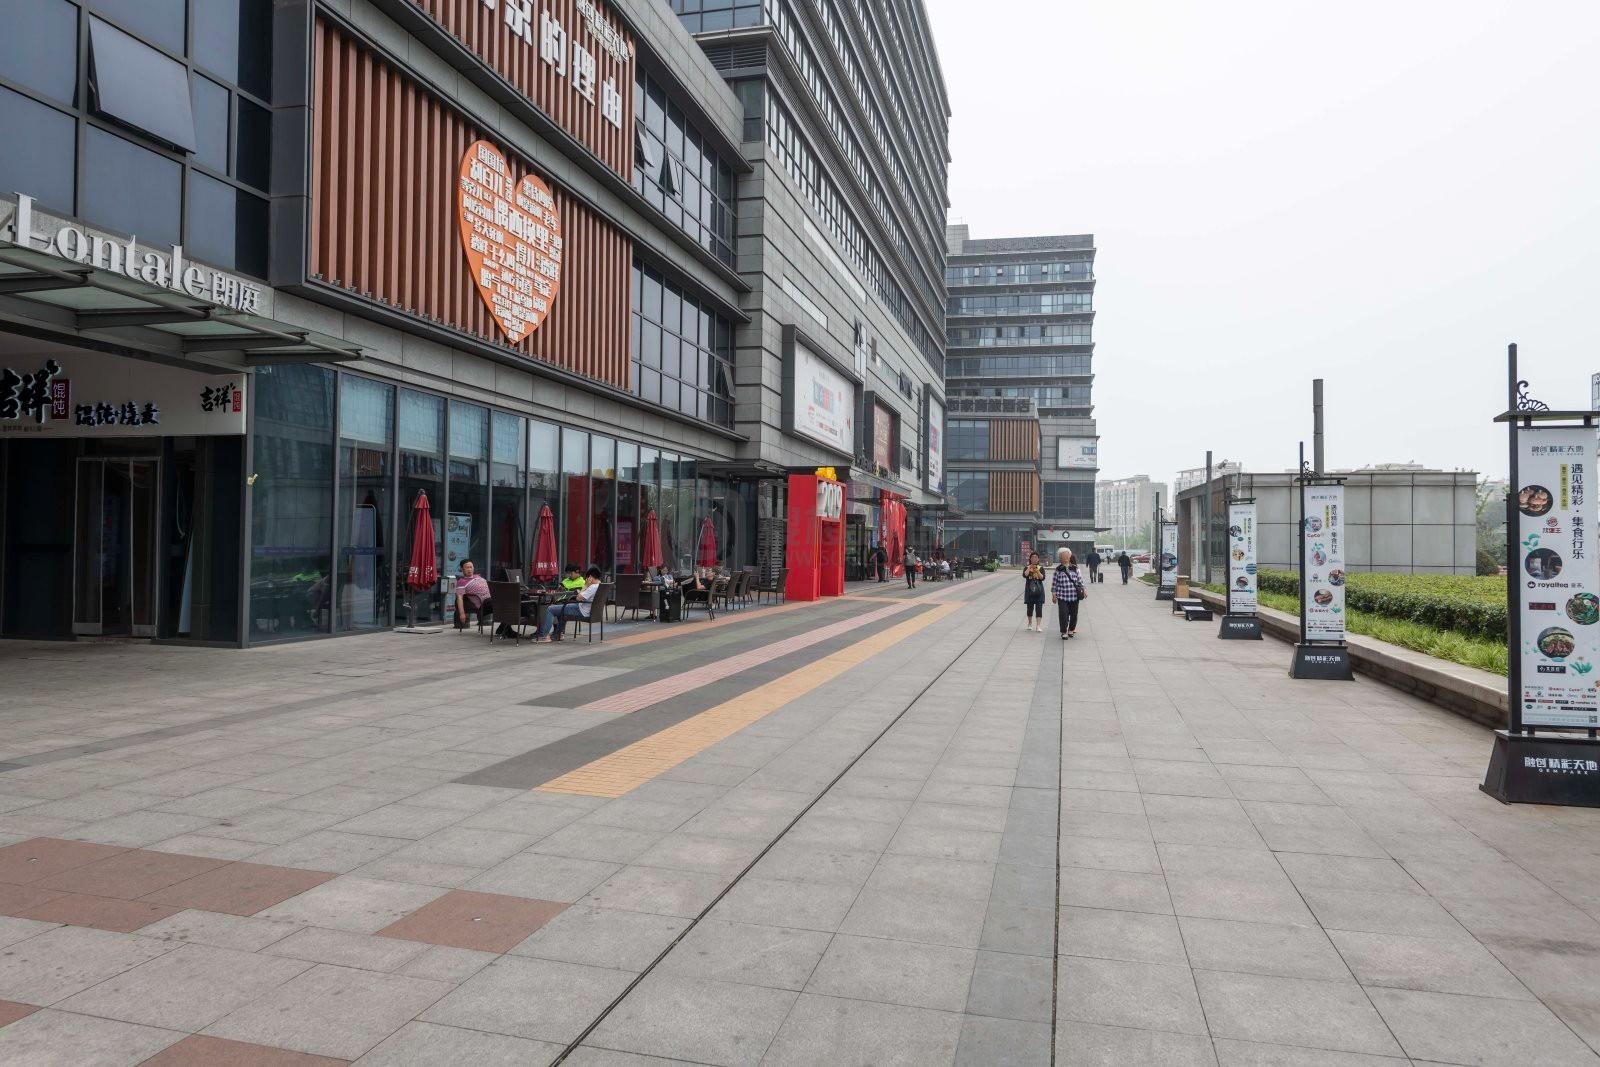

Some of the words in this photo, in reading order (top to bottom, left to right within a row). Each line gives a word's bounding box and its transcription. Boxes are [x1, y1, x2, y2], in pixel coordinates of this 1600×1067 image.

[13, 191, 206, 299] Lontale
[211, 271, 261, 315] 朗庭
[52, 381, 66, 415] 馄饨
[200, 382, 236, 414] 吉祥
[1570, 463, 1584, 560] 遇见精彩·集食行乐
[1524, 756, 1598, 771] 融创精彩天地
